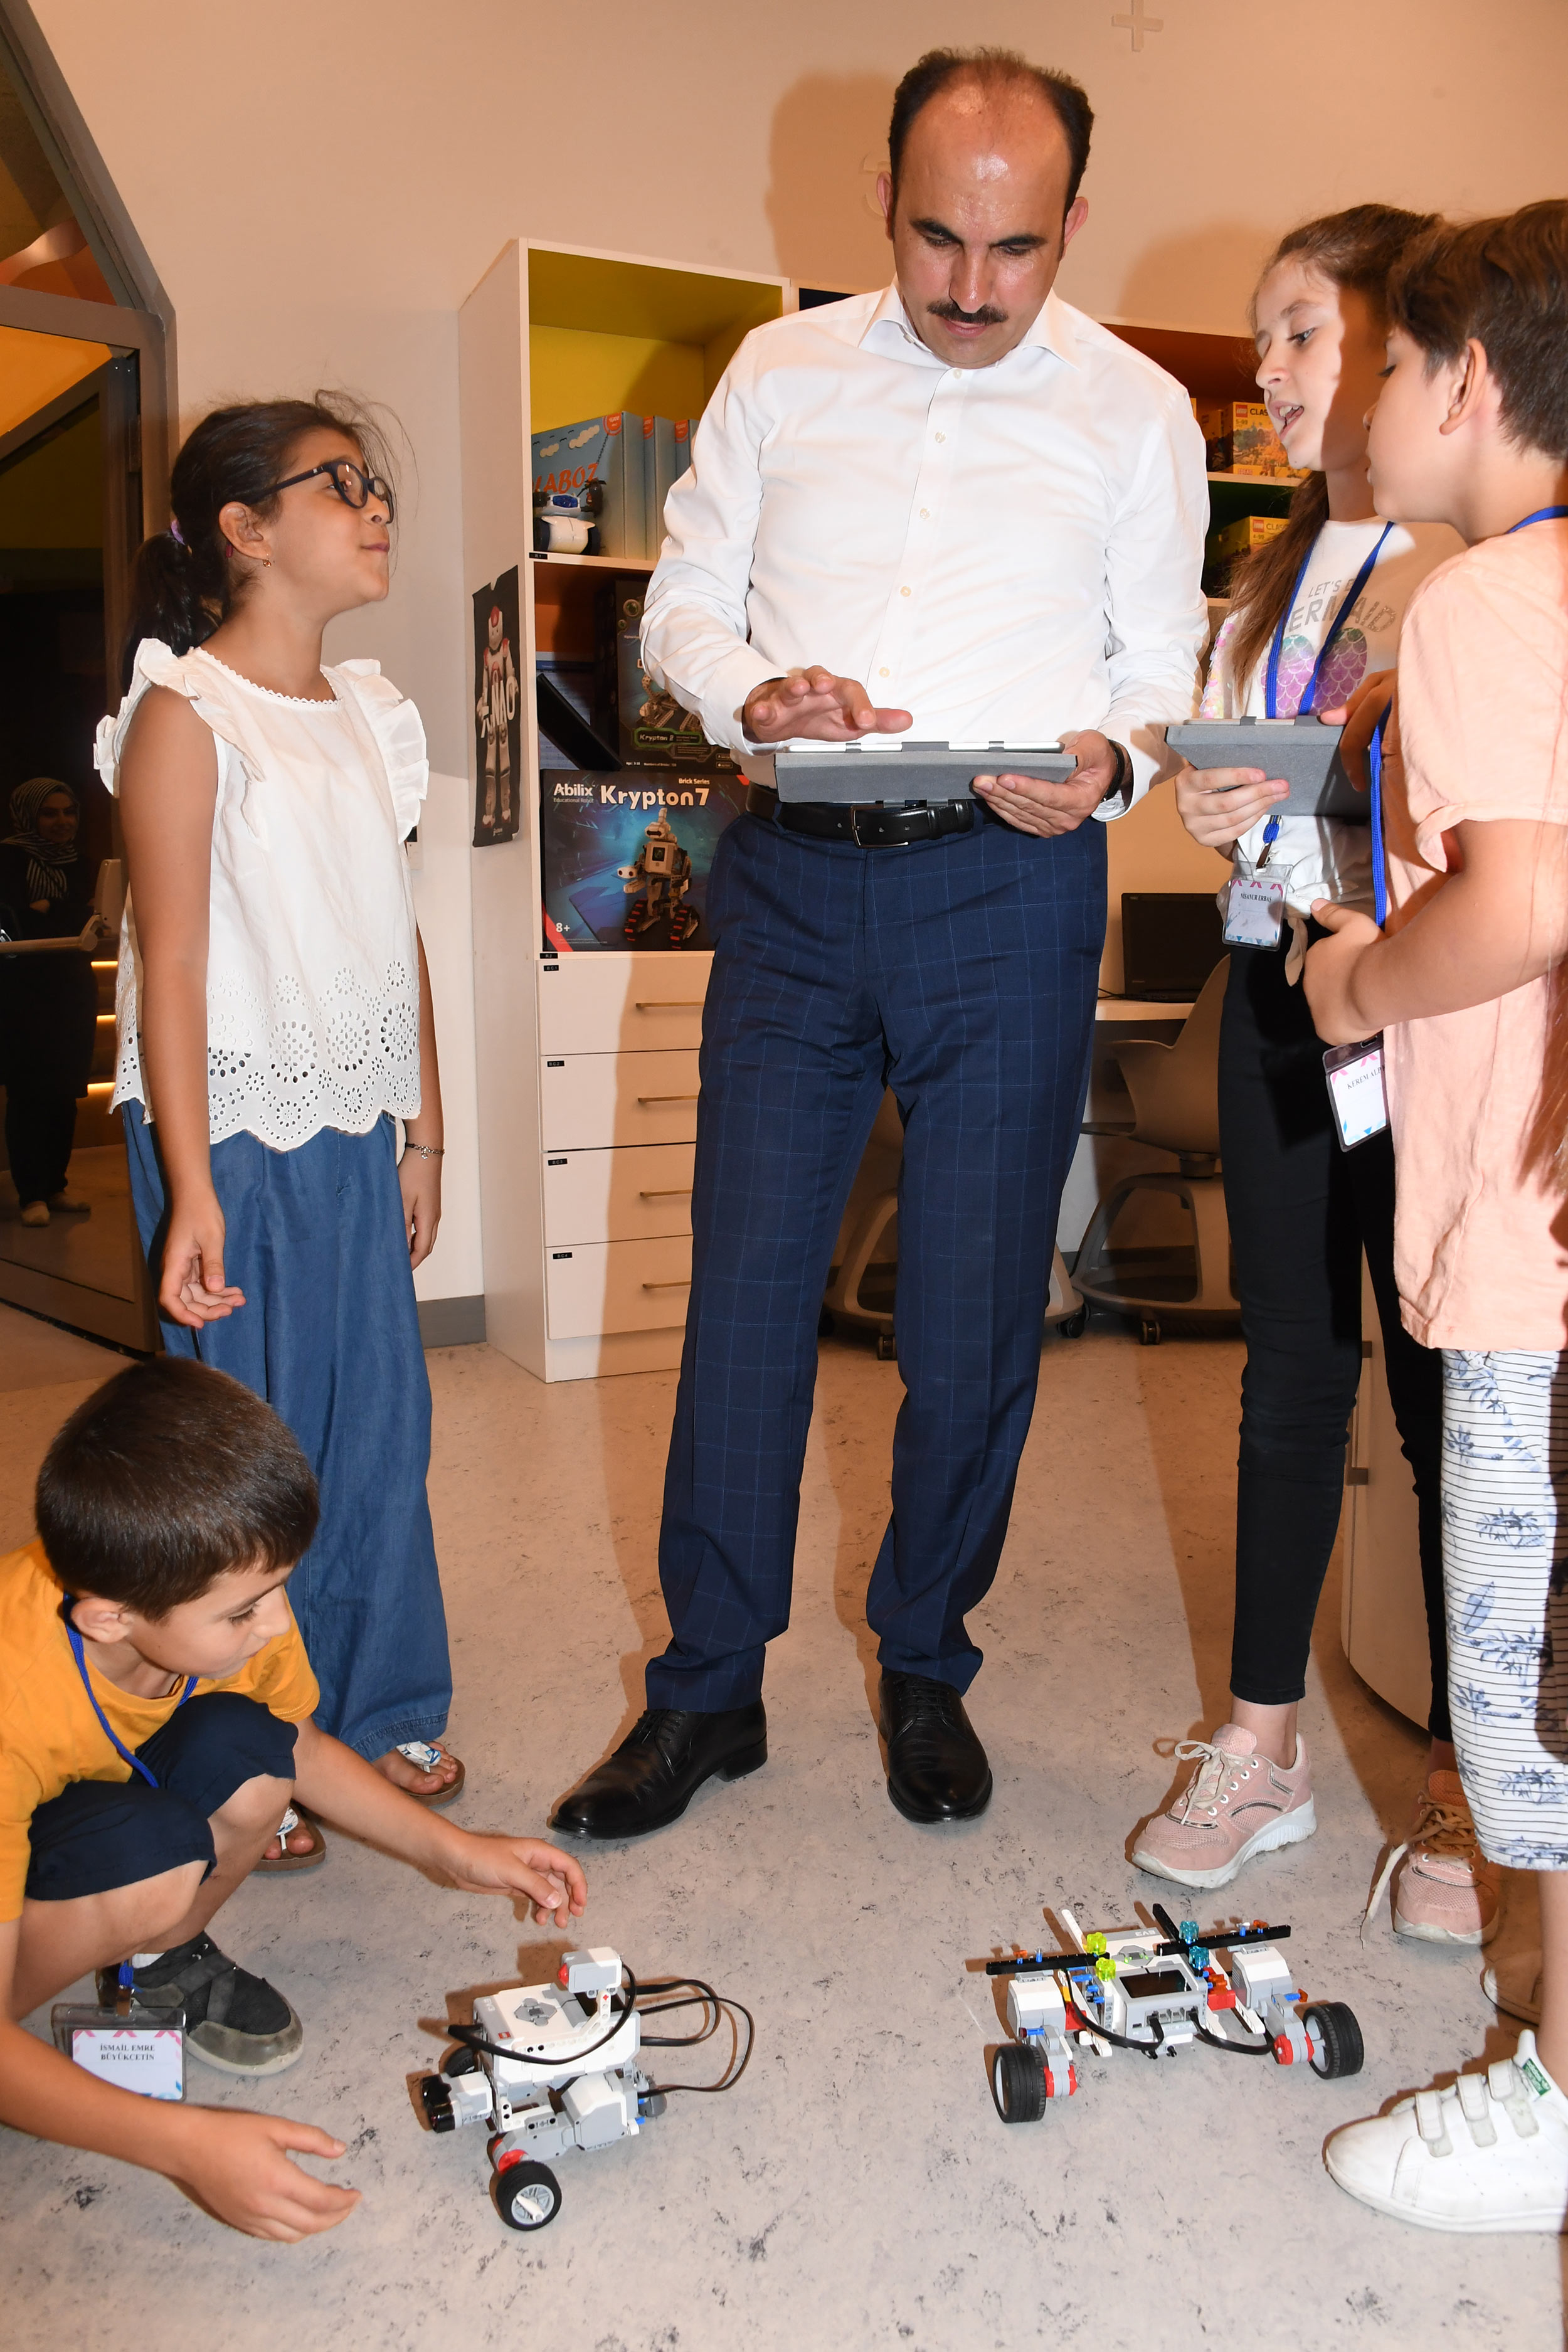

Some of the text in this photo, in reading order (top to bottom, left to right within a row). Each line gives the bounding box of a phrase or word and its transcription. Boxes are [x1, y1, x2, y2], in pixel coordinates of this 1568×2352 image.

[1308, 580, 1342, 598] LET'S
[1288, 595, 1396, 632] ERMAID
[553, 783, 593, 797] Abilix
[556, 923, 570, 933] 8+
[1347, 1073, 1369, 1089] KEREM
[100, 2043, 129, 2052] İSMAİL
